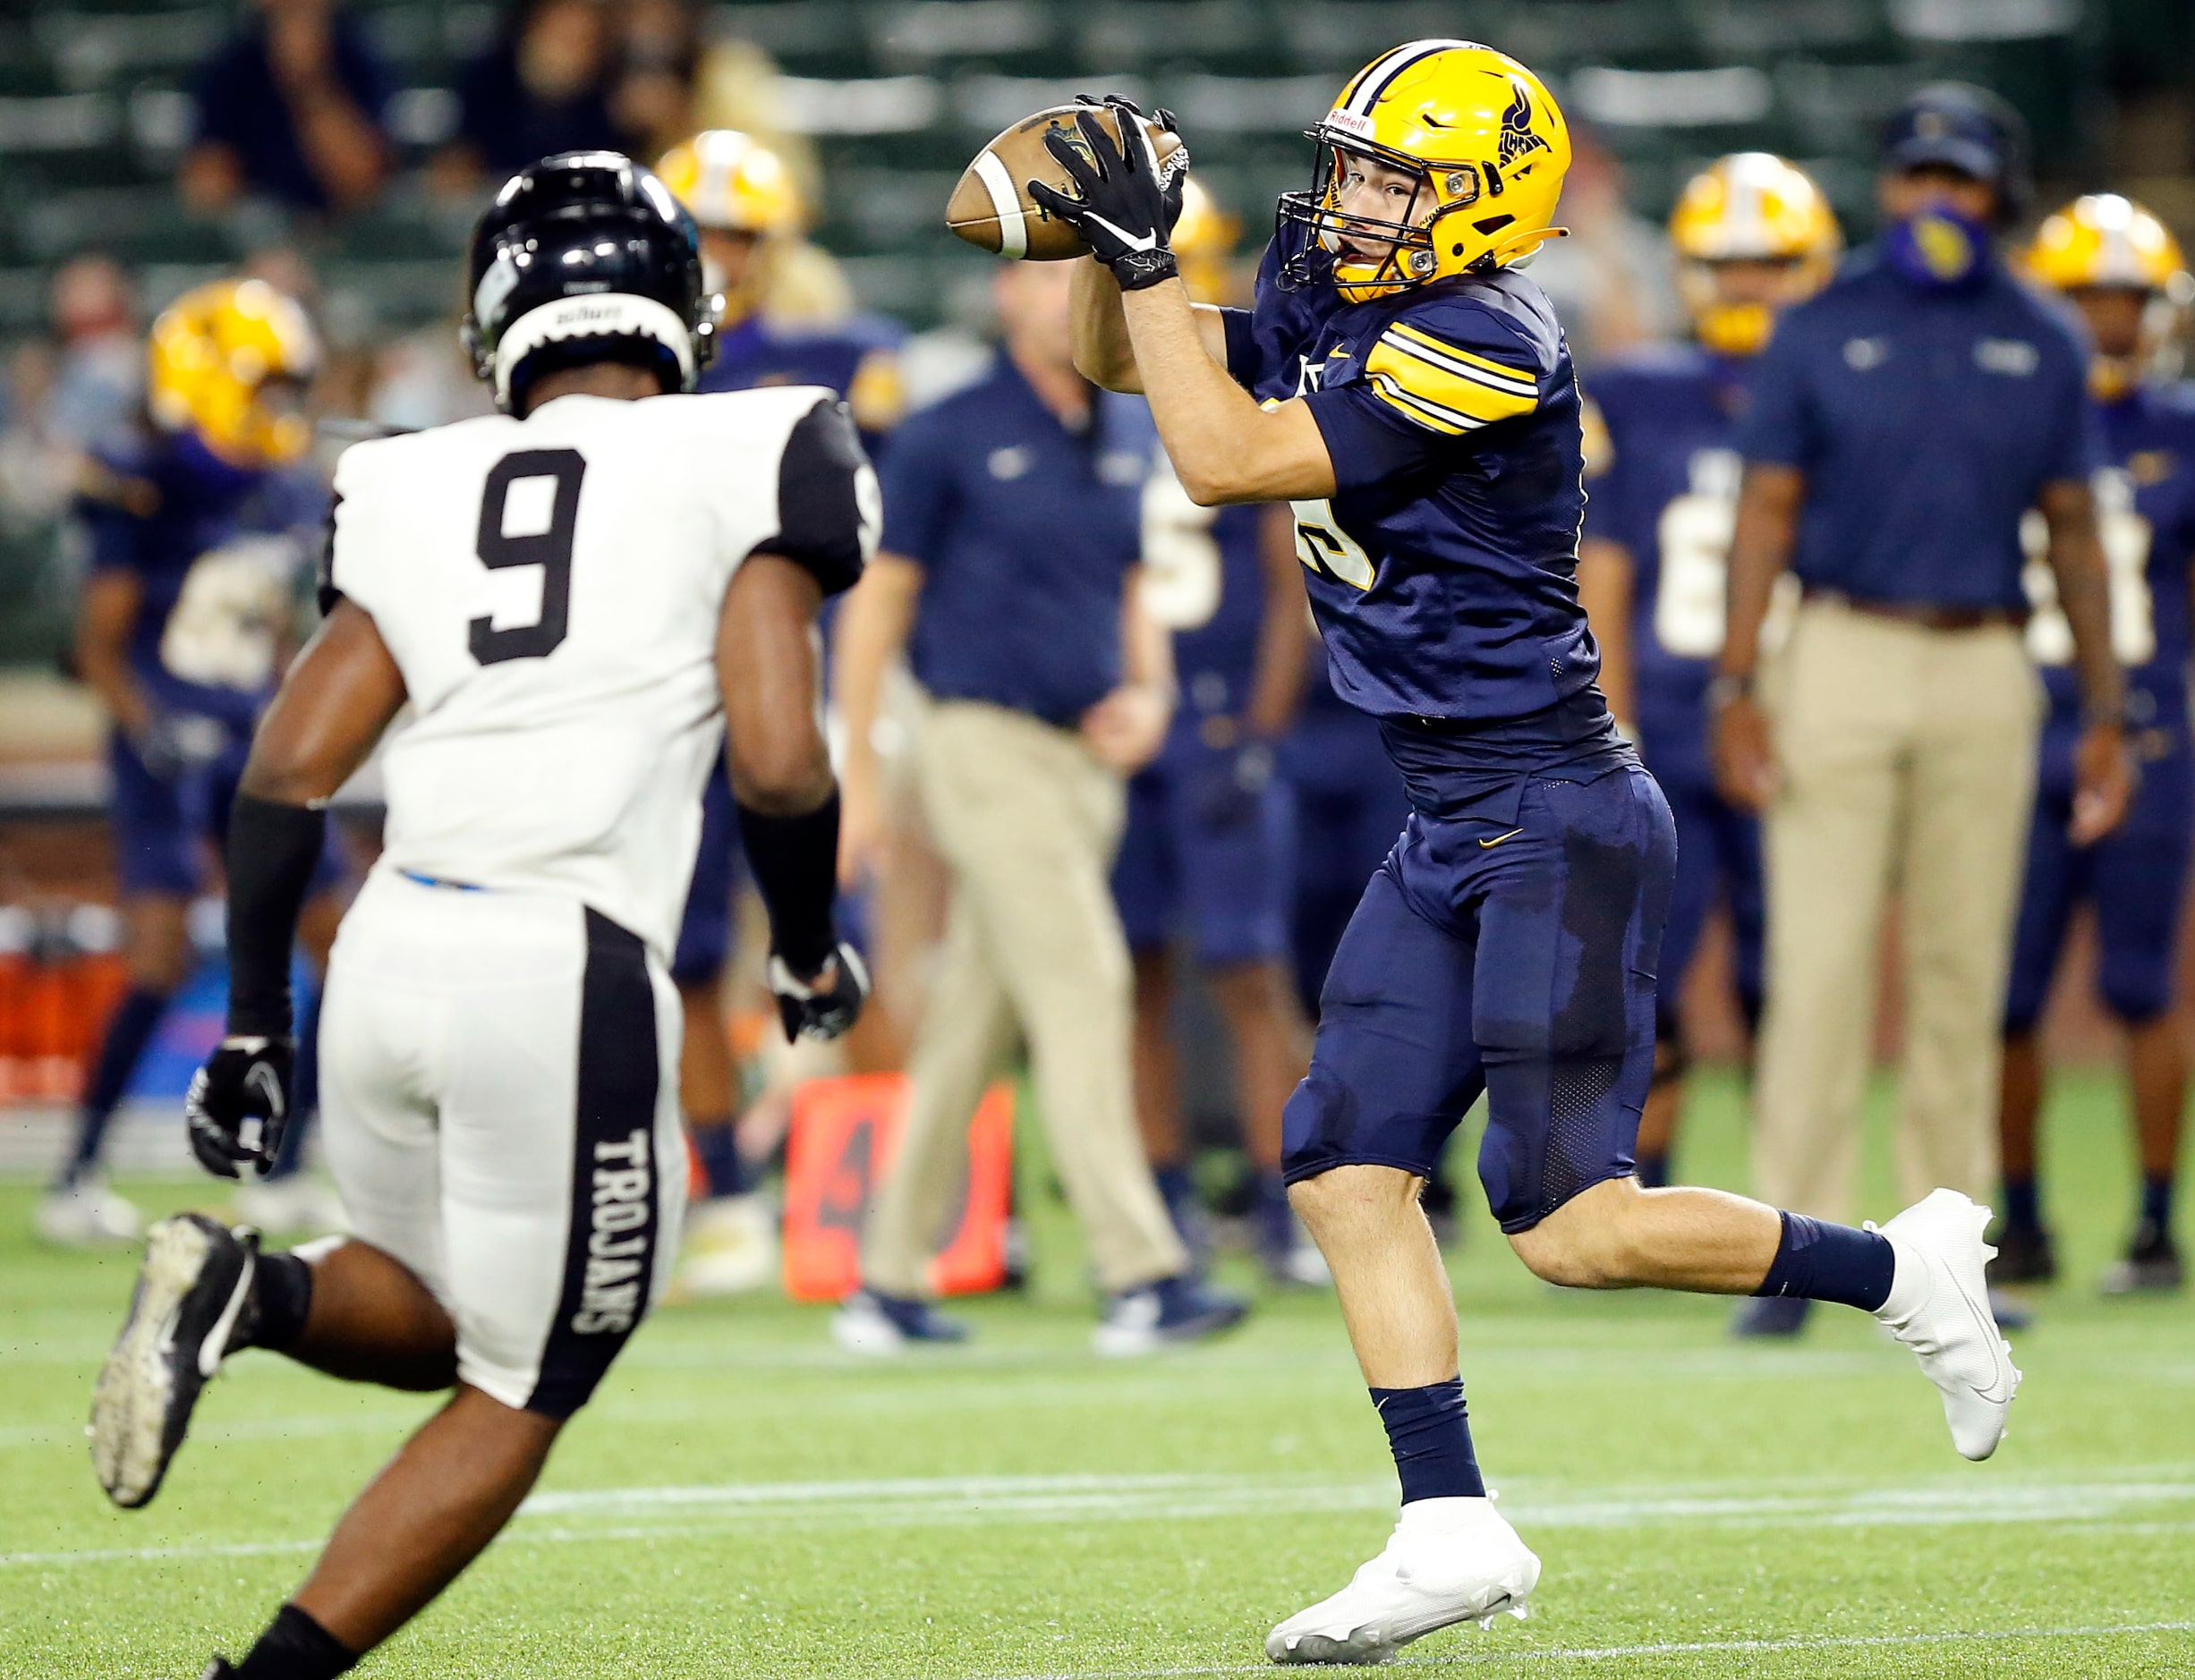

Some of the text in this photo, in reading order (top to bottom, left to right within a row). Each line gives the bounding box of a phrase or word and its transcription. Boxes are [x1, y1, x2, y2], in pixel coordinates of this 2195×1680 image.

[1330, 110, 1368, 132] Riddell
[469, 448, 587, 666] 9
[571, 1127, 651, 1336] TROJANS
